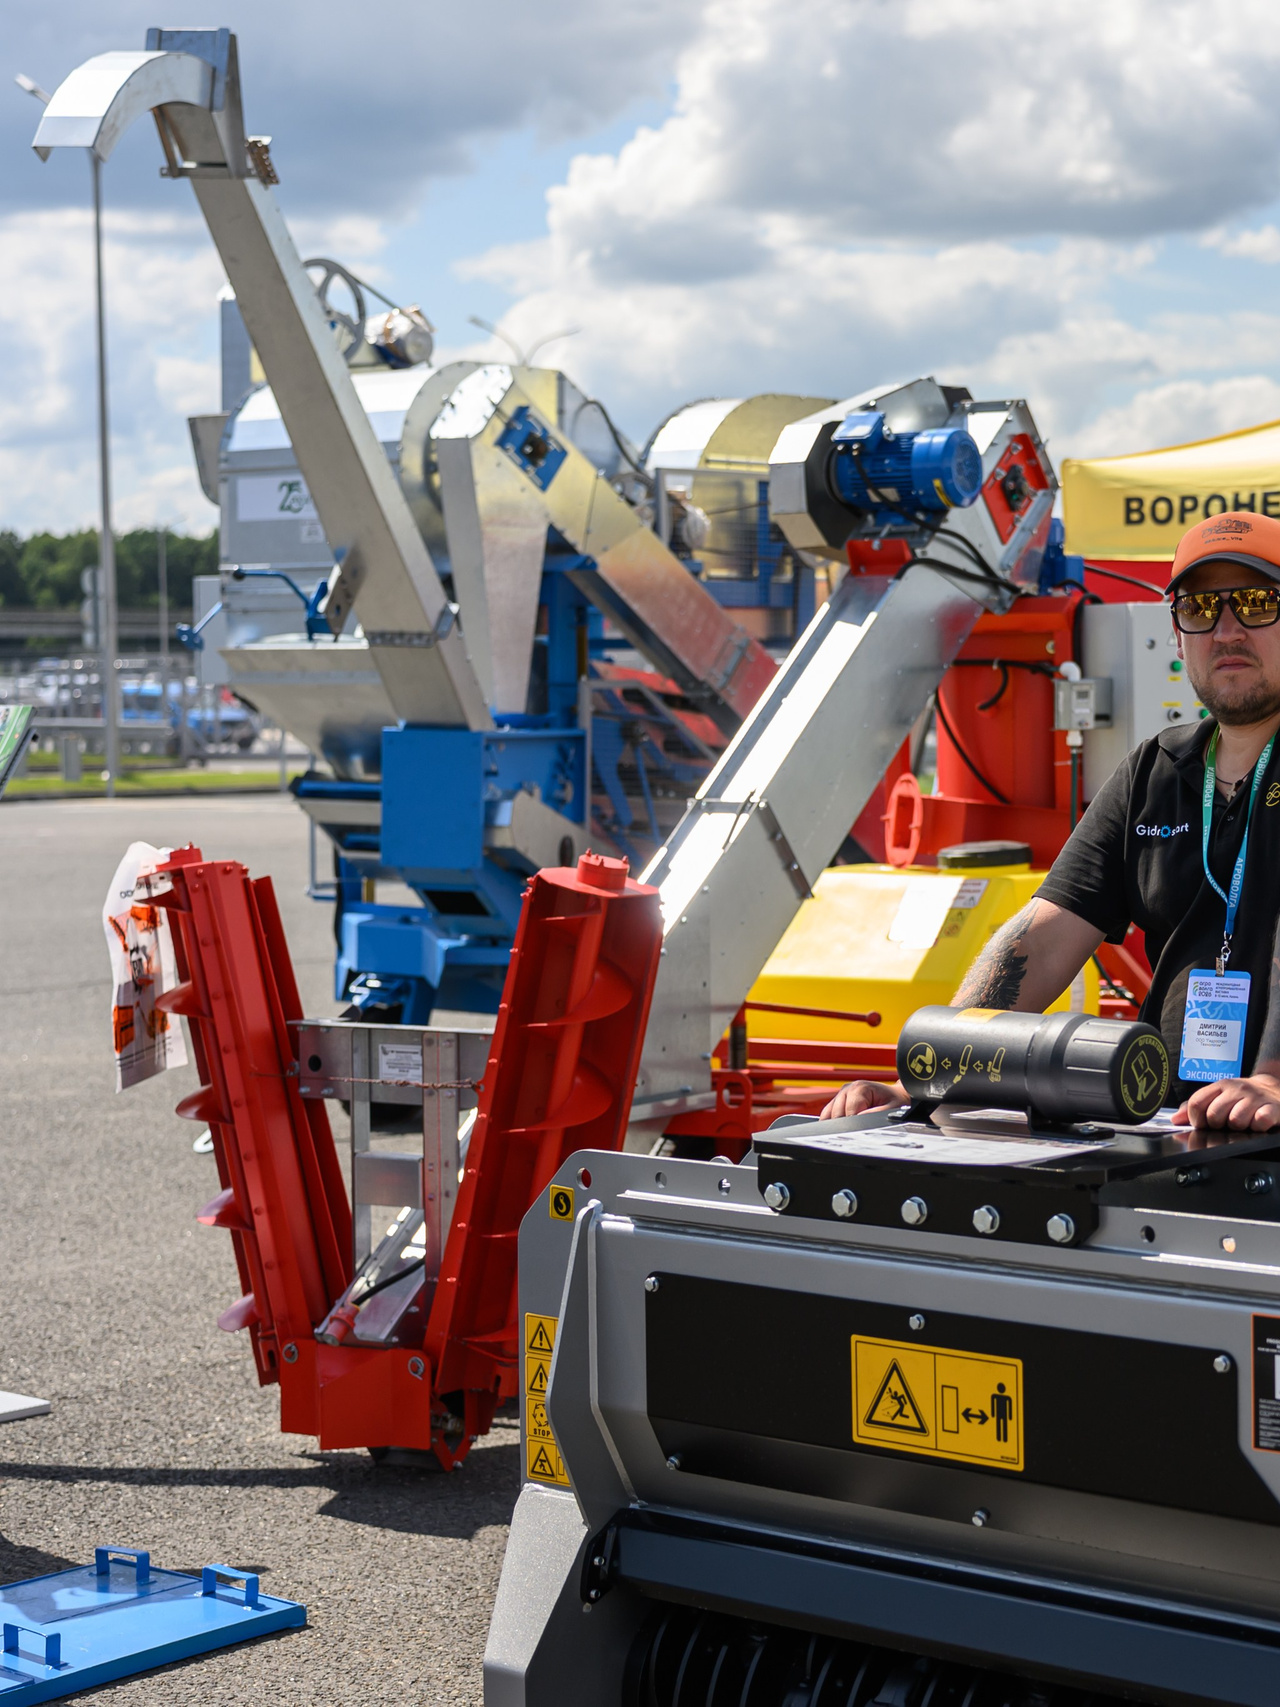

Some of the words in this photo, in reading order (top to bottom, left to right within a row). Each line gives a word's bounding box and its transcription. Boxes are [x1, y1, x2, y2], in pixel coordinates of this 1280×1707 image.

[1204, 766, 1215, 807] АГРОВОЛГА
[1254, 743, 1272, 791] АГРОВОЛГА
[1229, 857, 1244, 908] АГРОВОЛГА
[1186, 1070, 1235, 1080] ЭКСПОНЕНТ
[533, 1428, 551, 1437] STOP
